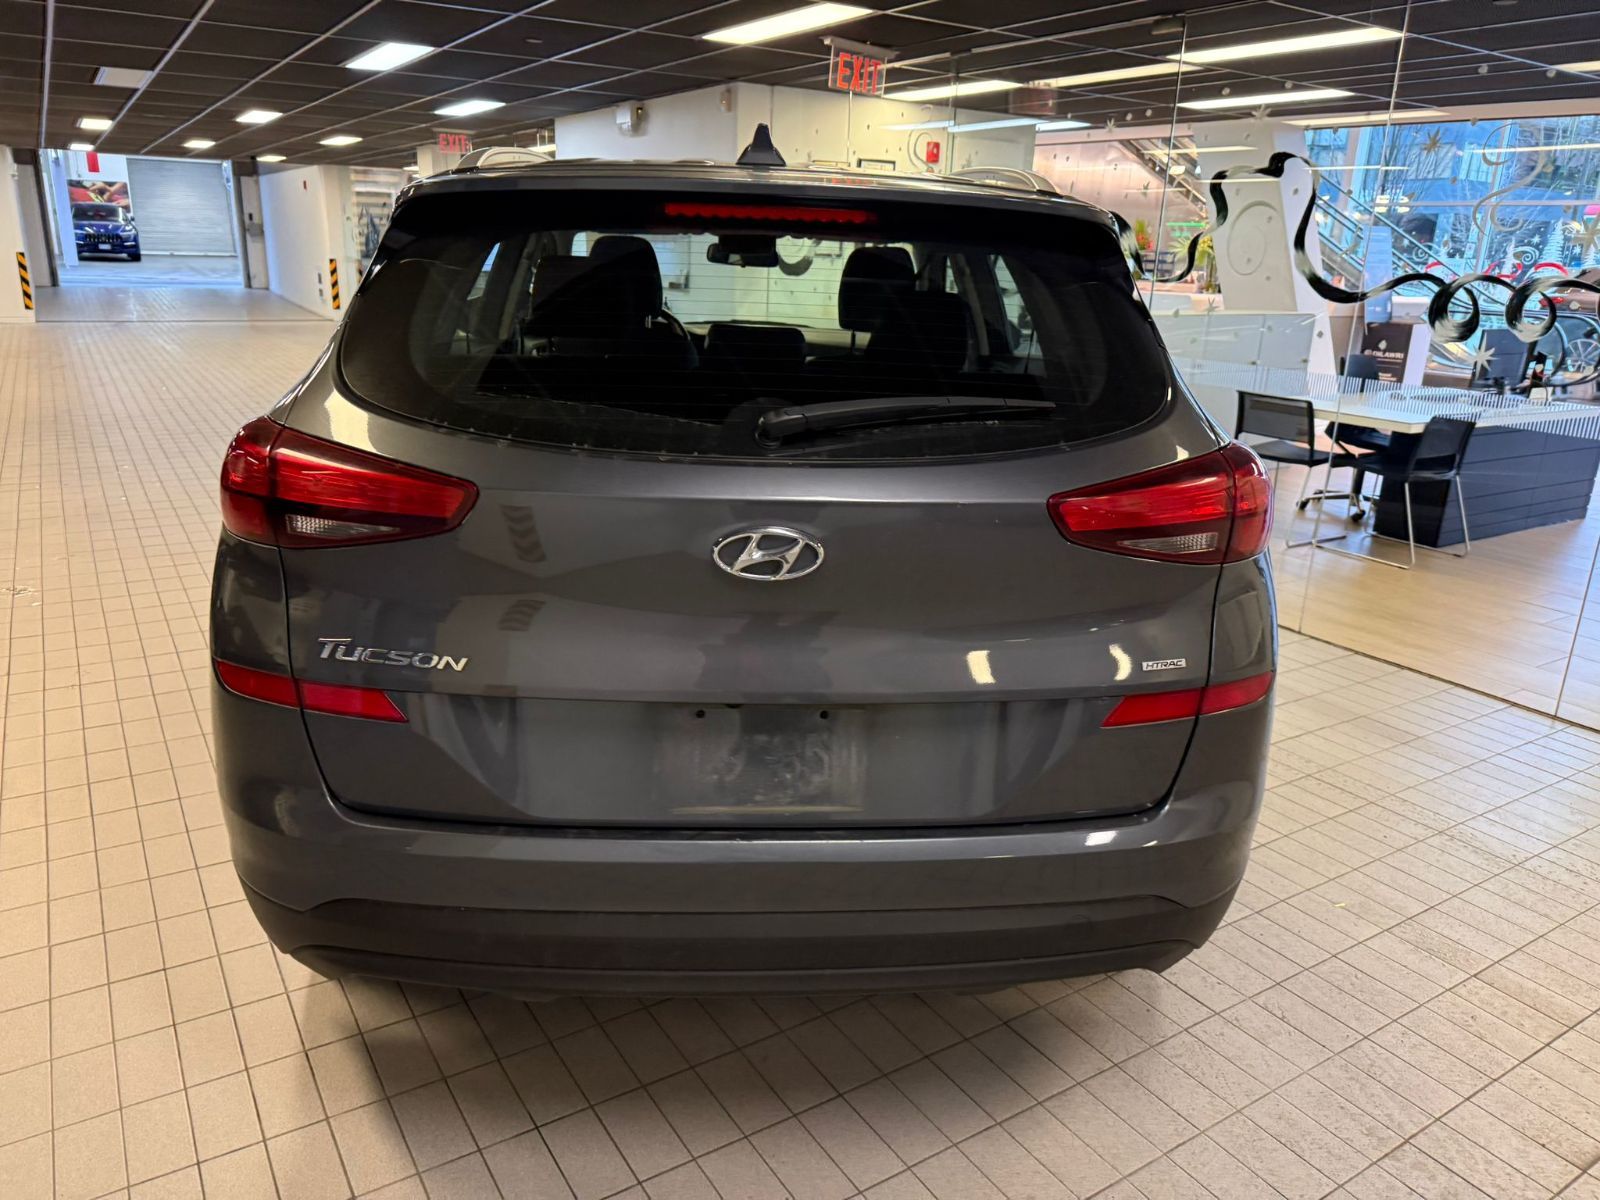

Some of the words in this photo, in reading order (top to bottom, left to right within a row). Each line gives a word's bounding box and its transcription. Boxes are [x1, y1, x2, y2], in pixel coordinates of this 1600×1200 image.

[837, 52, 882, 95] EXIT
[438, 133, 468, 154] EXIT
[318, 637, 469, 672] TUCSON
[1144, 660, 1185, 670] HTRAC
